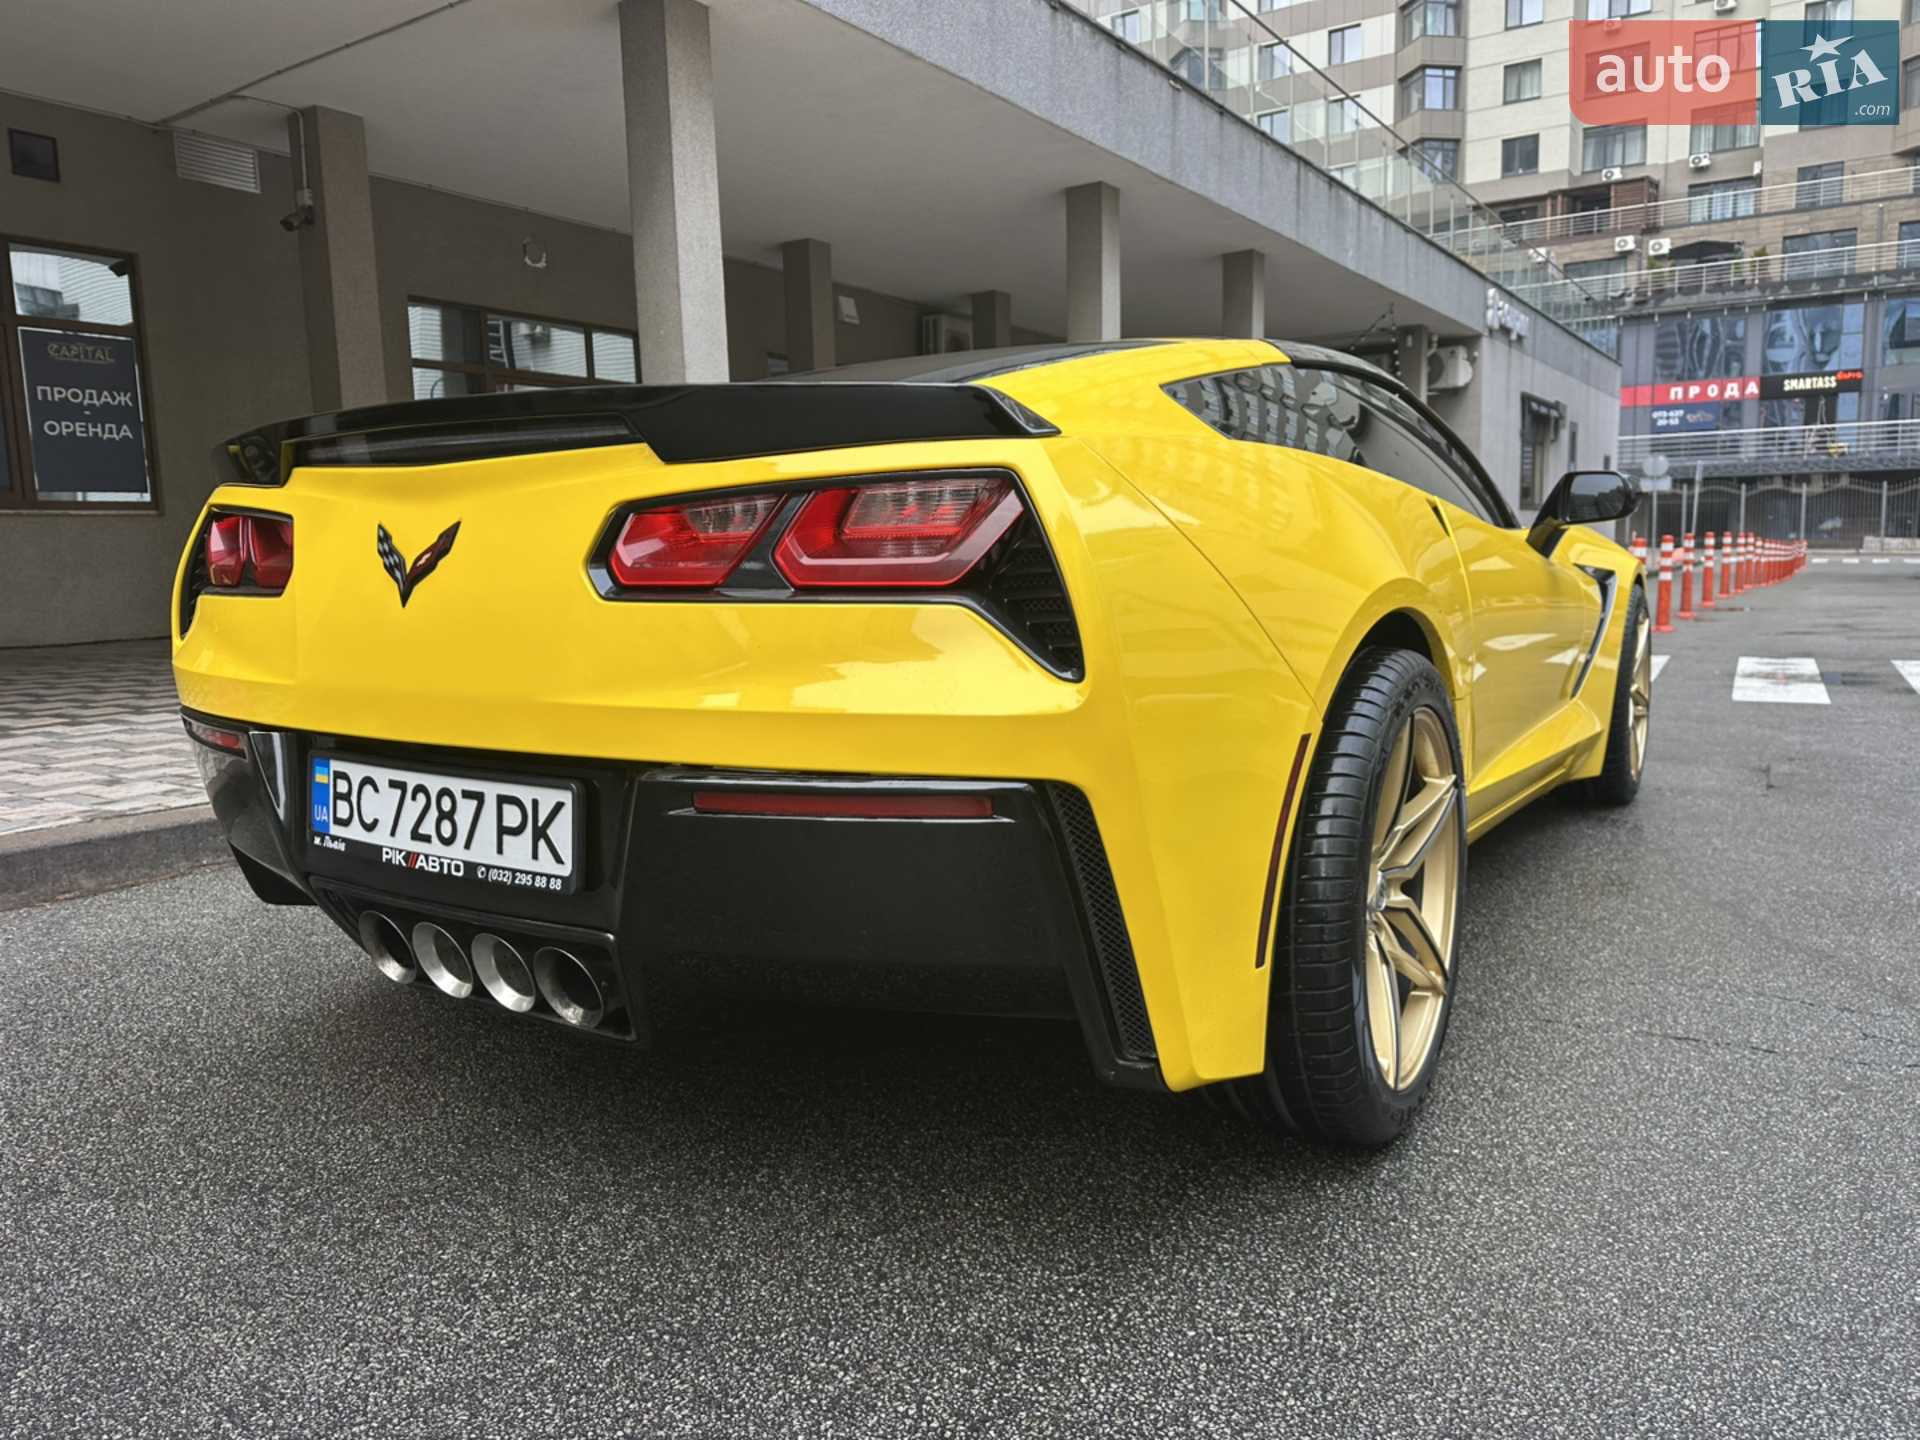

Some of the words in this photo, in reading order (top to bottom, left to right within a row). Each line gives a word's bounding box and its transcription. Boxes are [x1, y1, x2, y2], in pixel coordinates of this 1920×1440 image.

[47, 343, 115, 362] CAPITAL
[1783, 375, 1837, 391] SMARTASS
[36, 385, 133, 407] ПРОДАЖ
[44, 420, 134, 441] ОРЕНДА
[314, 804, 329, 823] UA
[488, 867, 513, 886] (032)
[514, 872, 533, 886] 295
[534, 875, 547, 888] 88
[549, 878, 562, 891] 88
